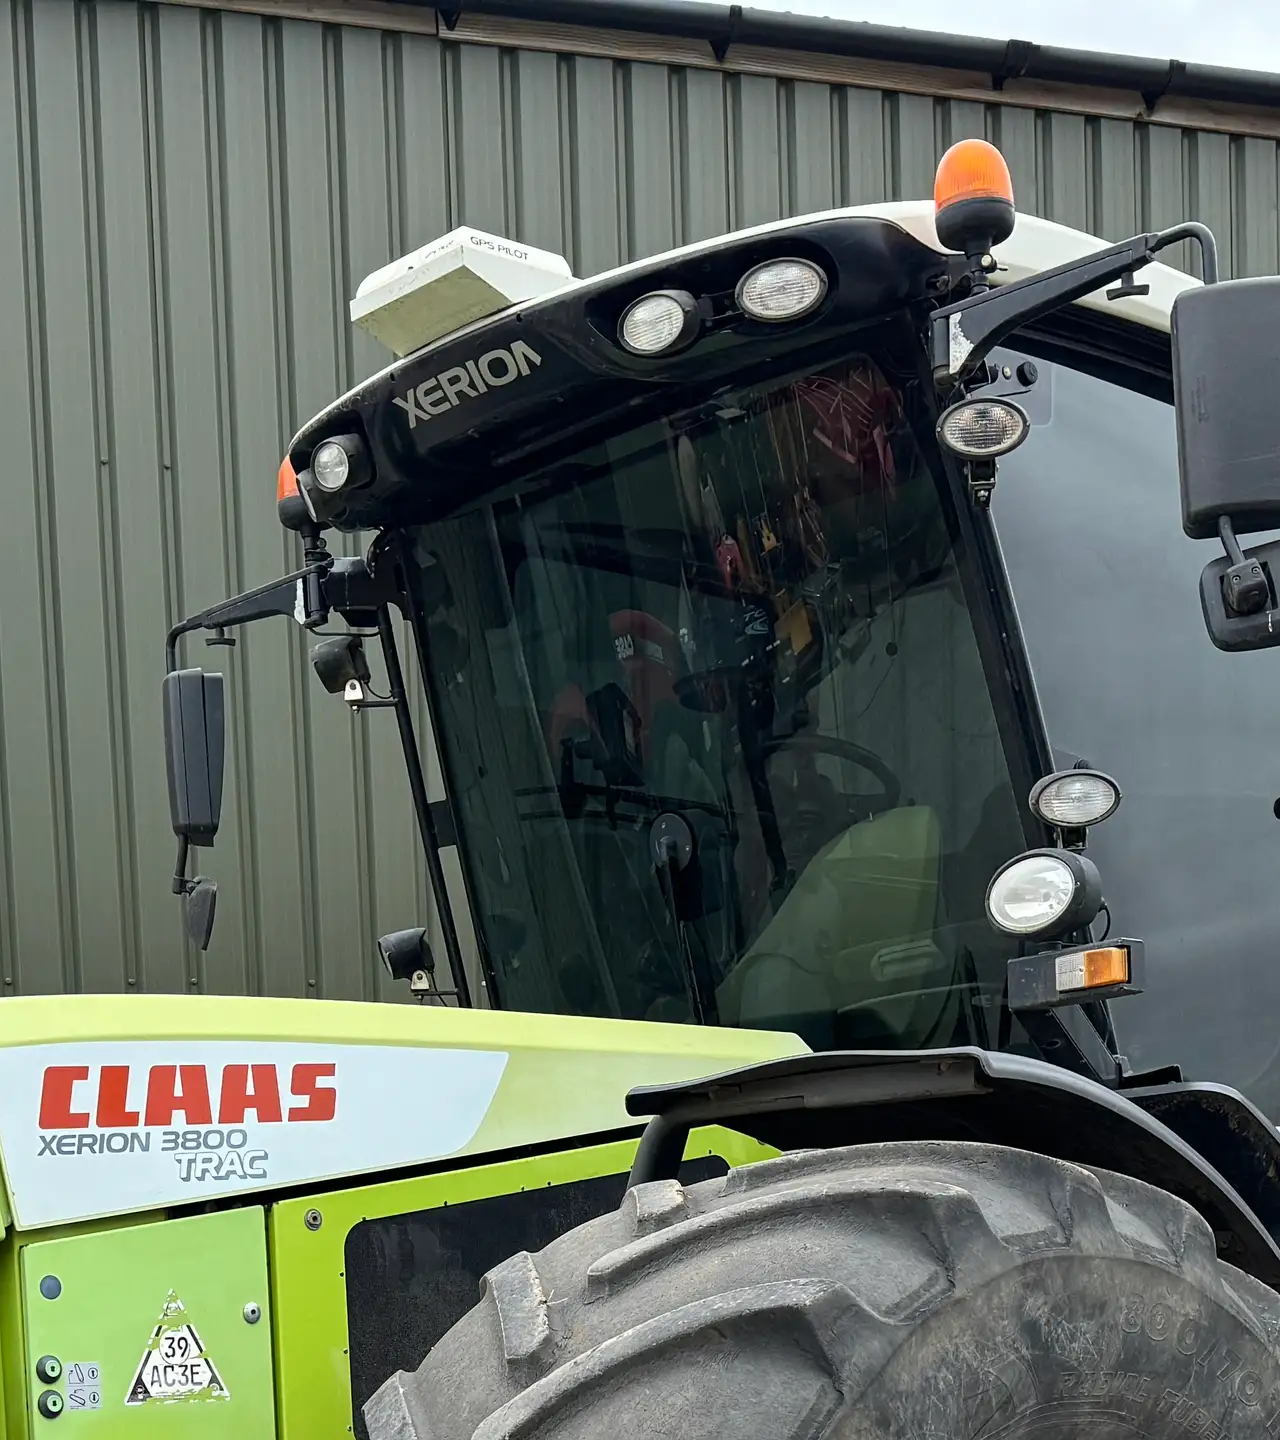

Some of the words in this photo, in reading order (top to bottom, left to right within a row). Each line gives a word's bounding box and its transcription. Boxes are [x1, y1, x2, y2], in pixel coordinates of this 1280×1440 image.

[470, 236, 495, 250] GPS
[497, 244, 529, 260] PILOT
[392, 340, 542, 429] XERION
[38, 1063, 336, 1129] CLAAS
[37, 1132, 151, 1156] XERION
[161, 1128, 248, 1152] 3800
[173, 1149, 269, 1182] TRAC
[164, 1336, 189, 1359] 39
[150, 1364, 203, 1387] AC3E
